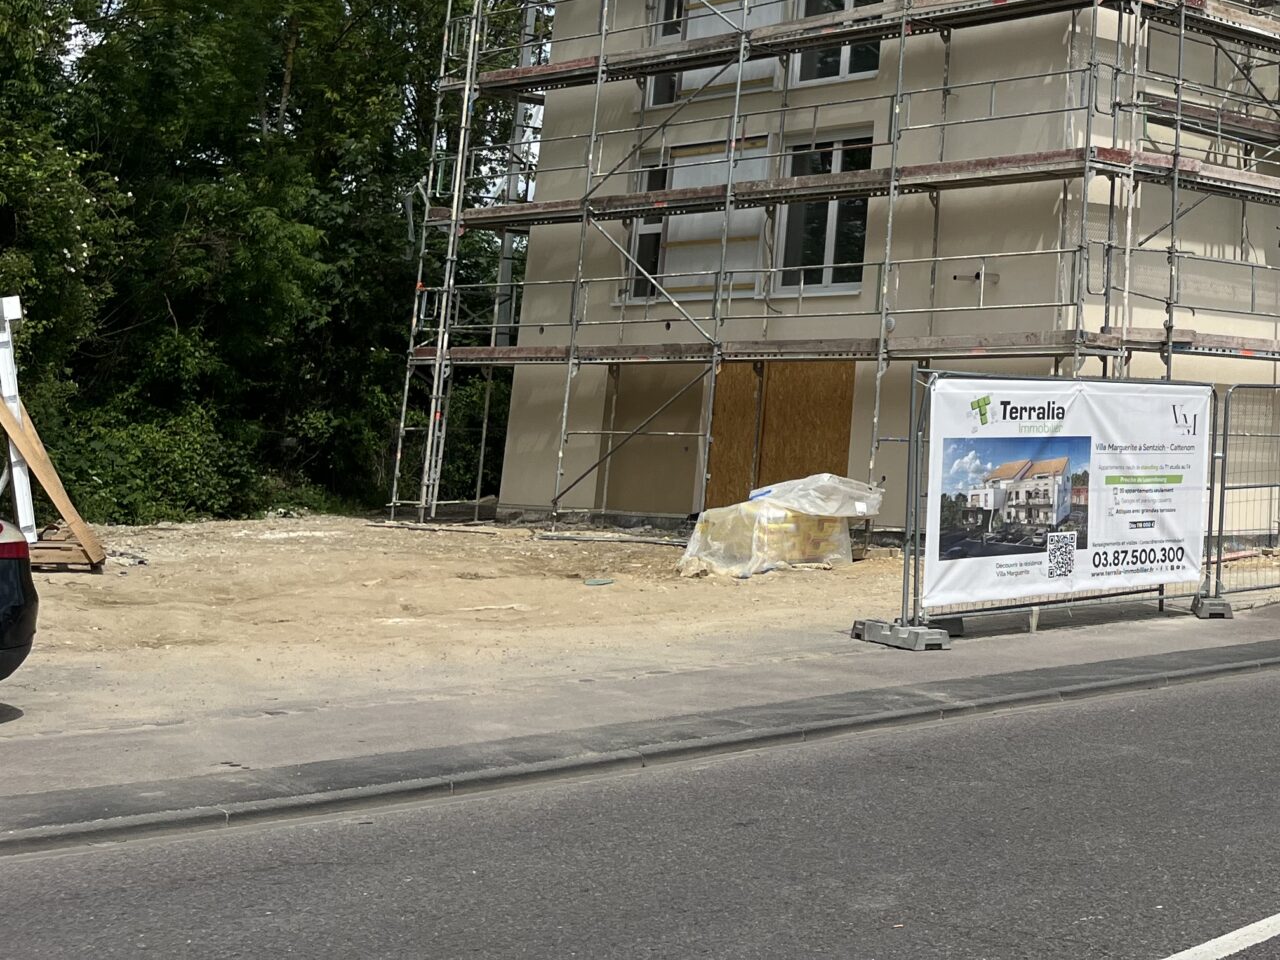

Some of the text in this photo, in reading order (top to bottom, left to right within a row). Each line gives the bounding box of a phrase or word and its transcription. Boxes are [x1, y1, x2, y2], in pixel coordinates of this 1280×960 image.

[1000, 400, 1065, 420] Terralia
[1019, 423, 1064, 433] Immobilier
[1095, 443, 1106, 451] Villa
[1108, 443, 1137, 453] Marguerite
[1170, 443, 1195, 451] Cattenom
[1092, 546, 1184, 568] 03.87.500.300
[1091, 567, 1154, 577] www.terralia-immobilier.fr
